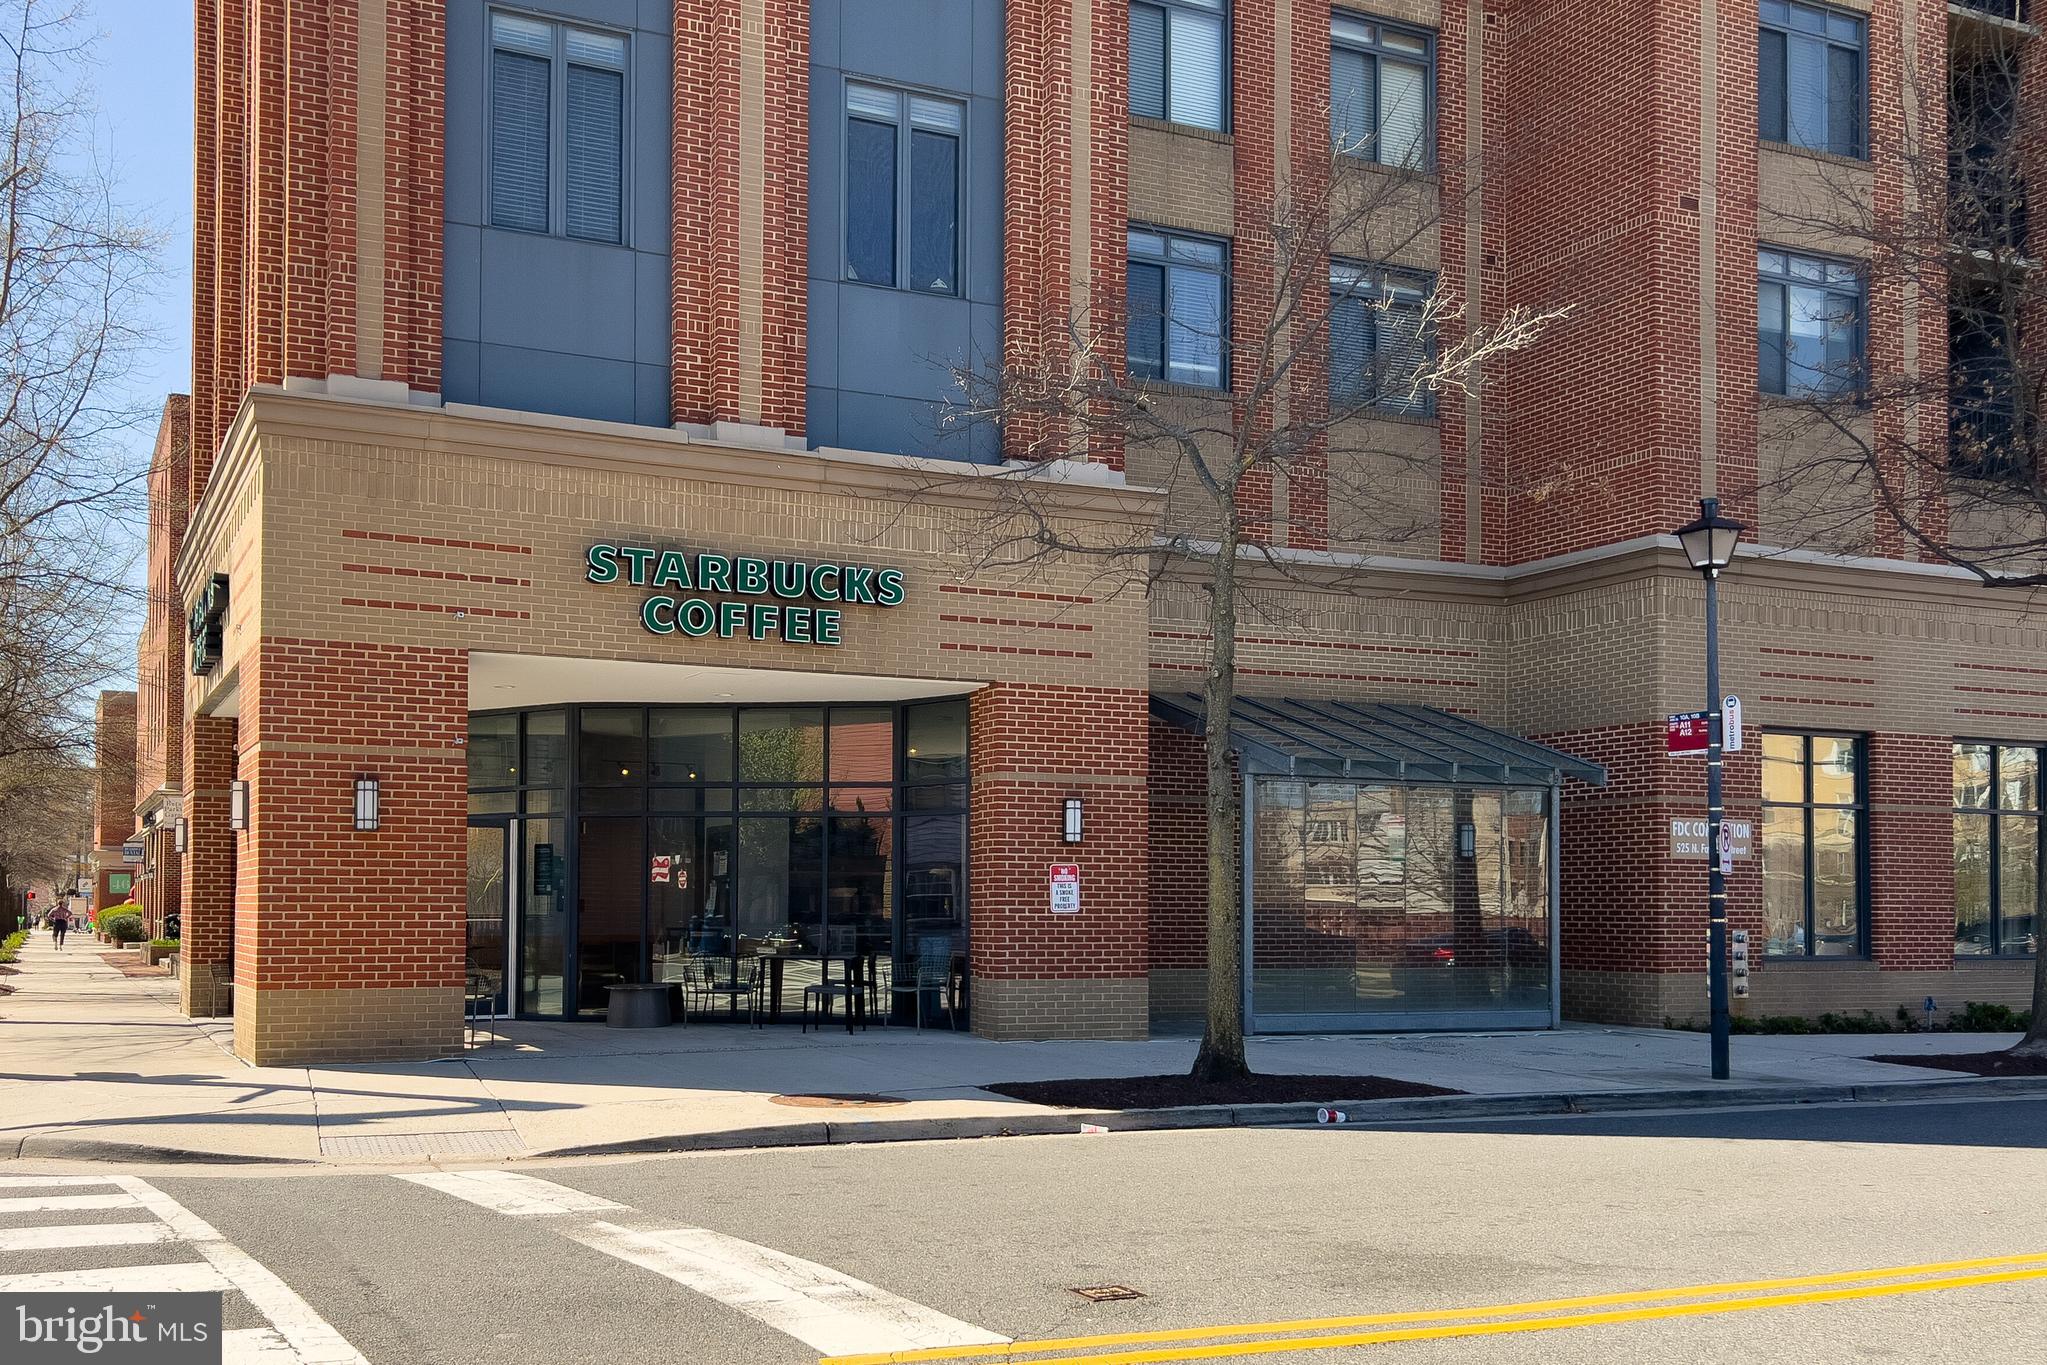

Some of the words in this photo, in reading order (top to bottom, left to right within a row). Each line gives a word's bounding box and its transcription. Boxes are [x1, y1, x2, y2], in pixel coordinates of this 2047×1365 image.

[587, 544, 905, 606] STARBUCKS
[641, 595, 841, 645] COFFEE
[1680, 721, 1691, 729] A11
[1672, 821, 1691, 837] FDC
[1676, 842, 1690, 854] 525
[1691, 844, 1700, 854] N.
